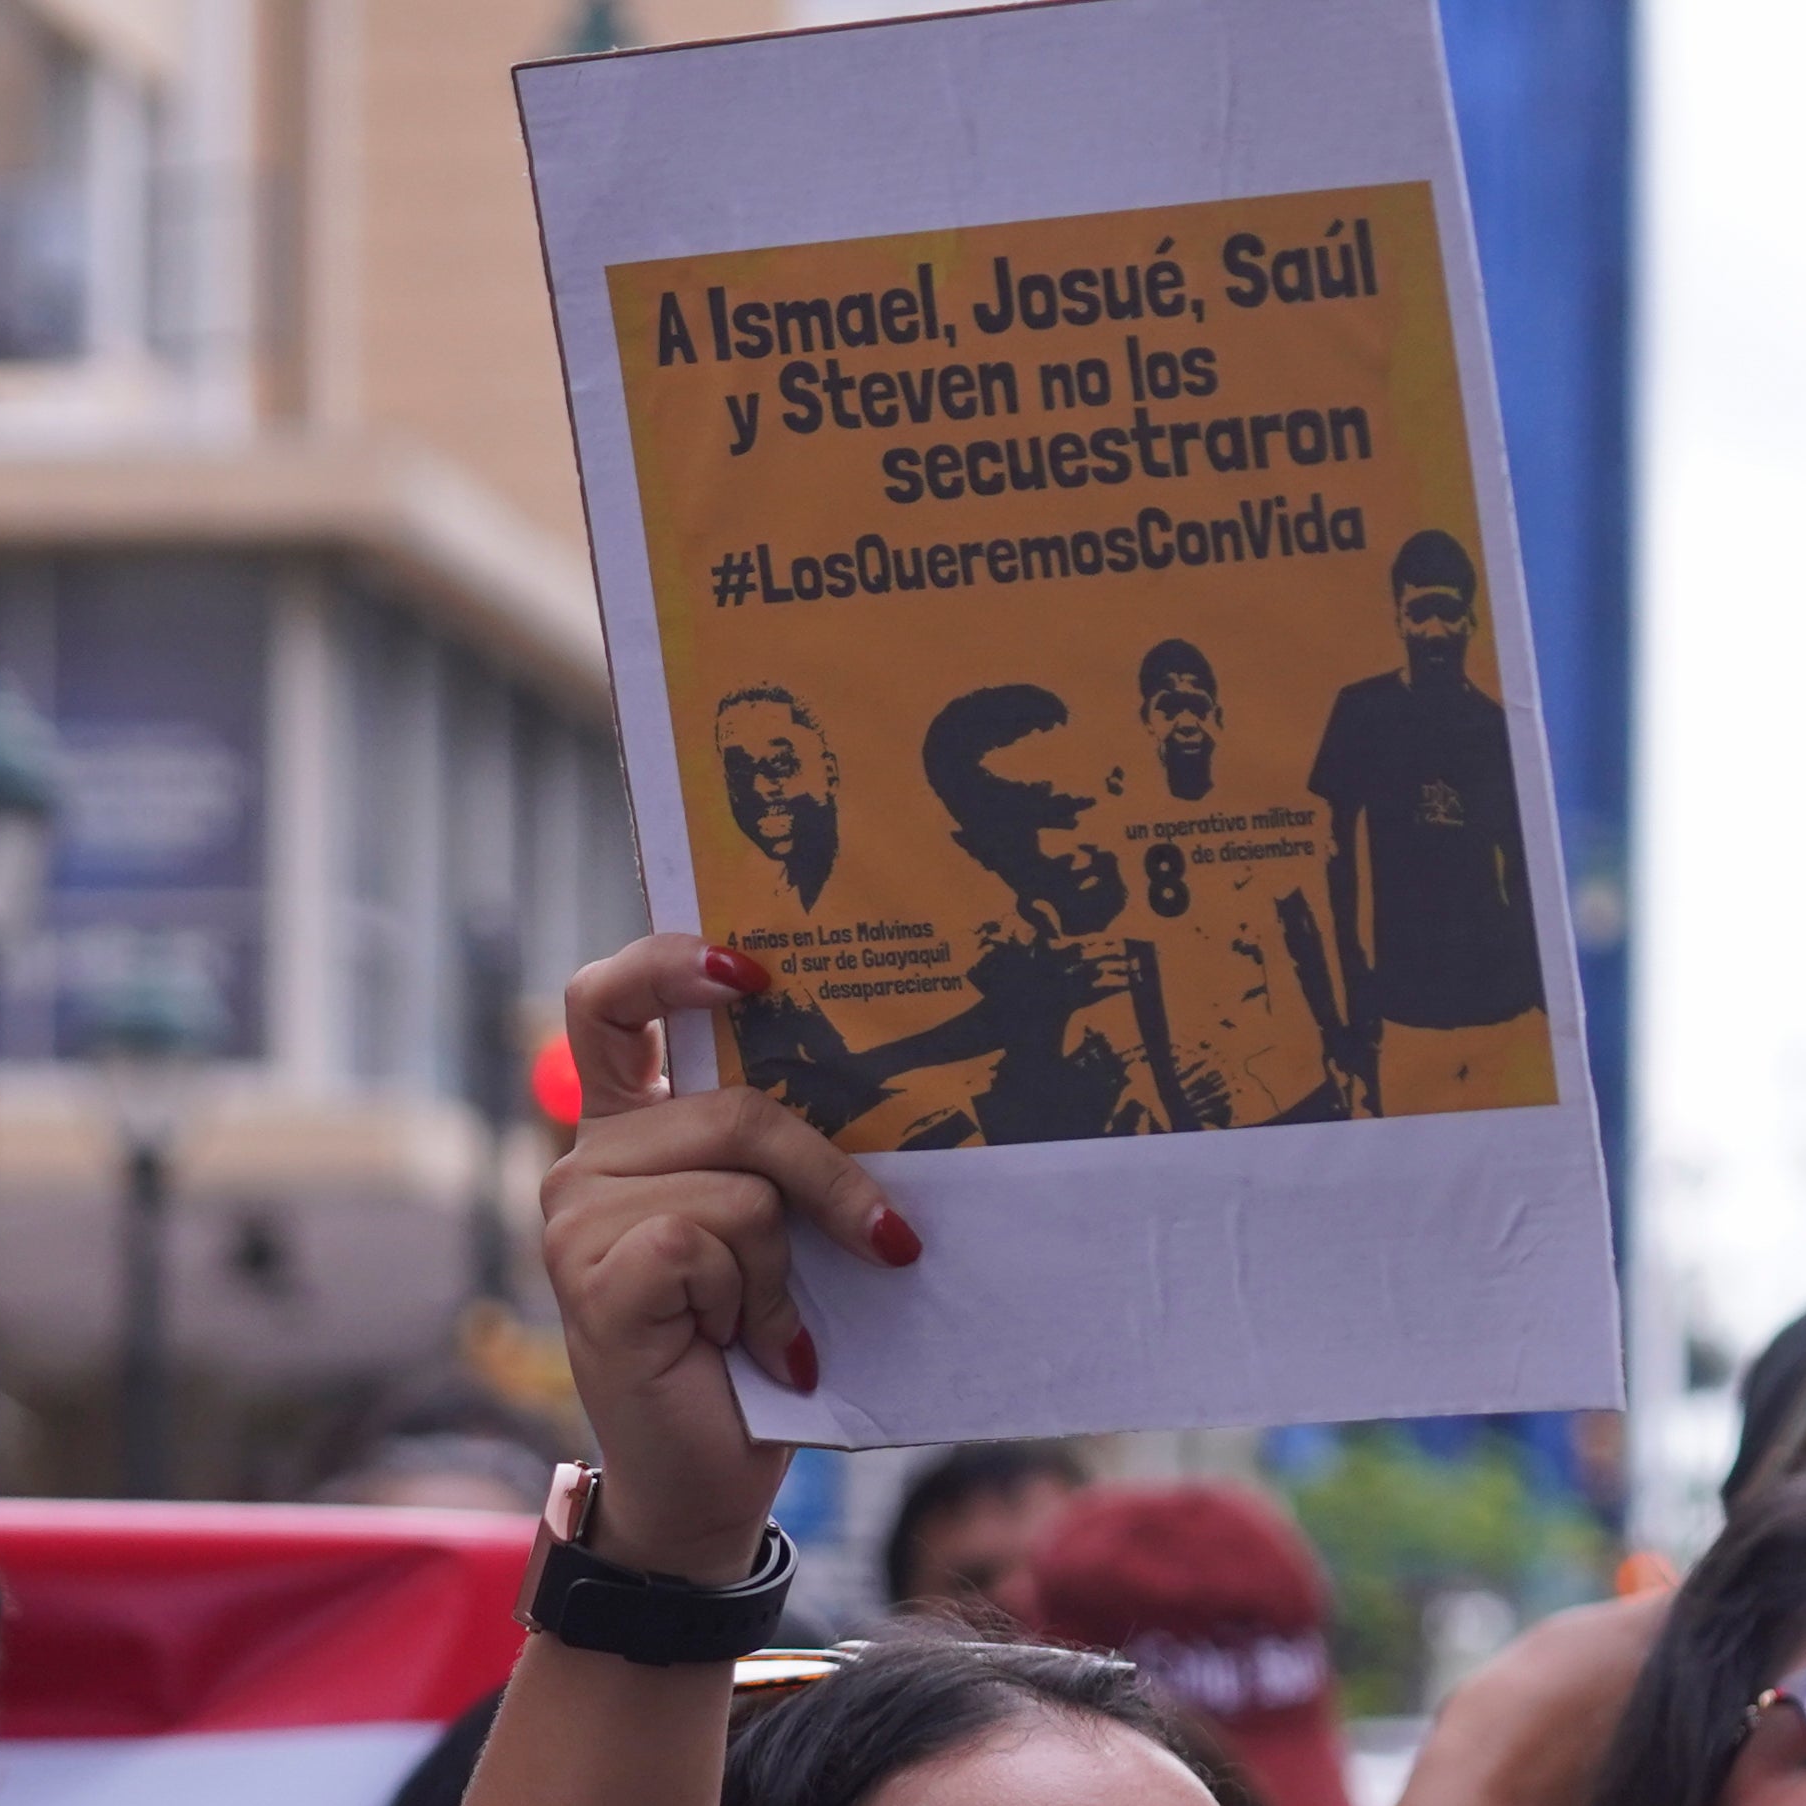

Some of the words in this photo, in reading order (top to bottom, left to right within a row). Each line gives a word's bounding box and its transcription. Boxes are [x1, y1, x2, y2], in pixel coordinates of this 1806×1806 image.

[658, 291, 698, 367] A
[707, 262, 958, 362] Ismael,
[973, 236, 1206, 335] Josué,
[1223, 218, 1379, 309] Saúl
[724, 391, 761, 457] y
[778, 358, 1020, 435] Steven
[1039, 357, 1112, 411] no
[1126, 334, 1219, 402] los
[881, 405, 1373, 504] secuestraron
[710, 493, 1366, 608] #LosQueremosConVida
[1125, 822, 1150, 841] un
[1152, 811, 1249, 842] operativo
[1251, 806, 1317, 831] militar
[1144, 843, 1192, 919] 8
[1191, 844, 1216, 865] de
[1219, 836, 1316, 861] diciembre
[726, 930, 739, 951] 4
[742, 927, 790, 951] niños
[793, 930, 813, 949] en
[817, 924, 853, 947] Las
[856, 920, 935, 944] Malvinas
[802, 955, 831, 973] sur
[835, 949, 857, 971] de
[863, 941, 952, 972] Guayaquil
[818, 972, 964, 1003] desaparecieron
